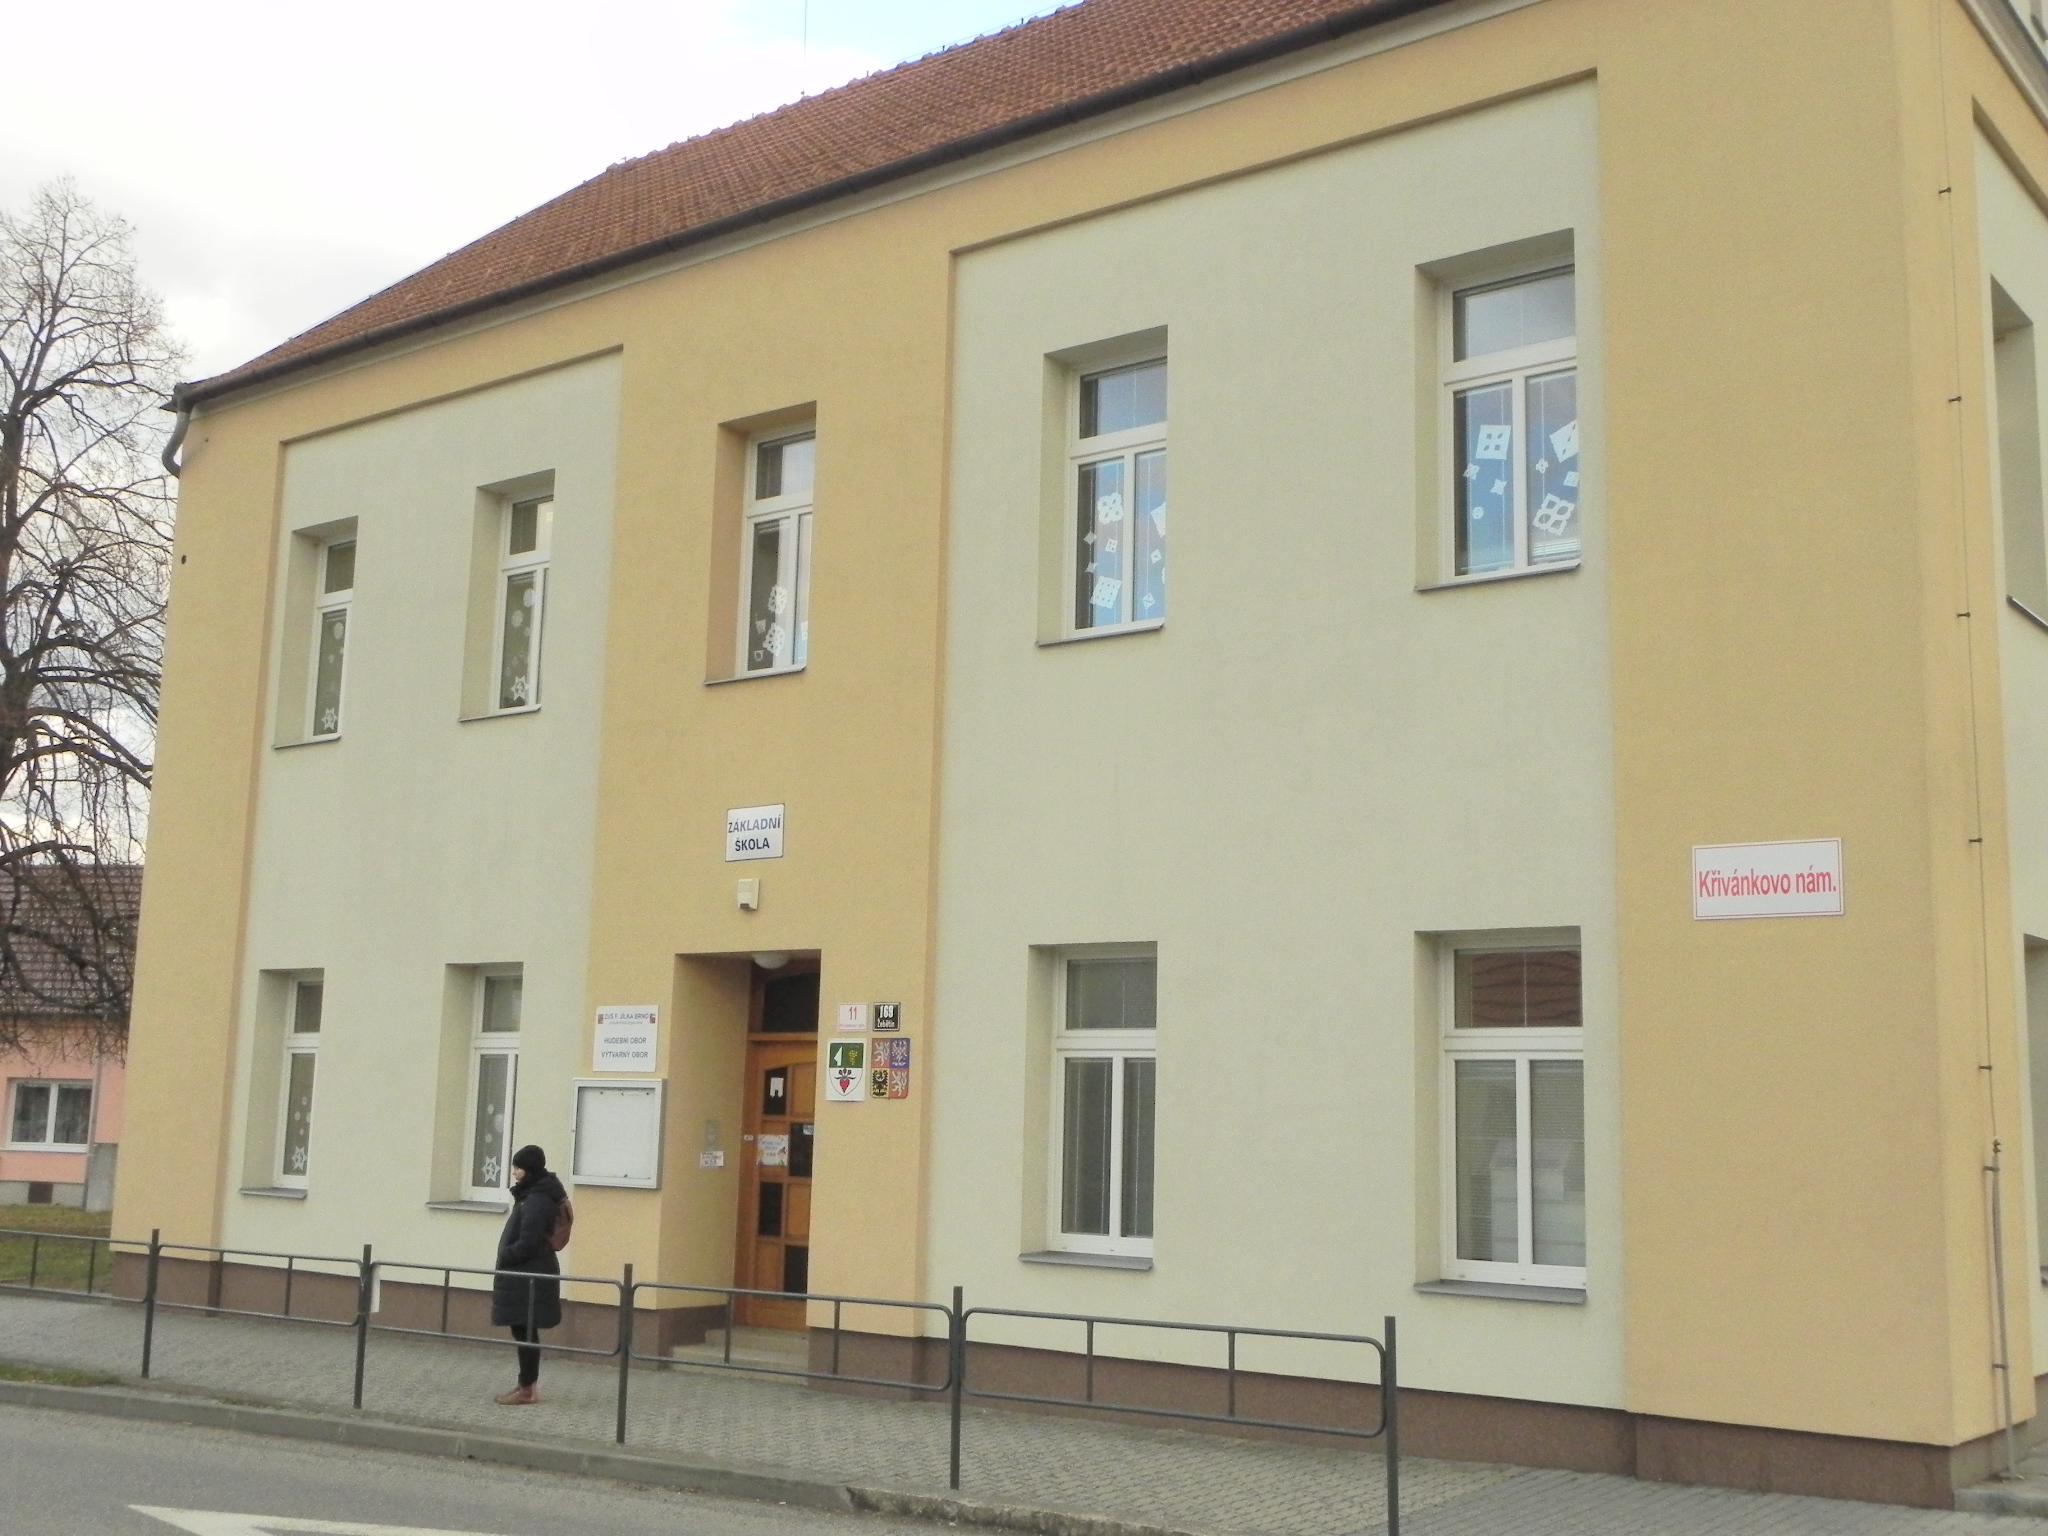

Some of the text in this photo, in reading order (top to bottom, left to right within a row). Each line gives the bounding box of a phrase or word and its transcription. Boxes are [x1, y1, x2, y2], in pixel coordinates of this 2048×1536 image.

[728, 814, 781, 834] ZÁKLADNÍ
[735, 837, 770, 852] ŠKOLA
[1698, 865, 1837, 898] Křivánkovo nám.
[848, 1006, 857, 1020] 11
[879, 1005, 894, 1018] 169
